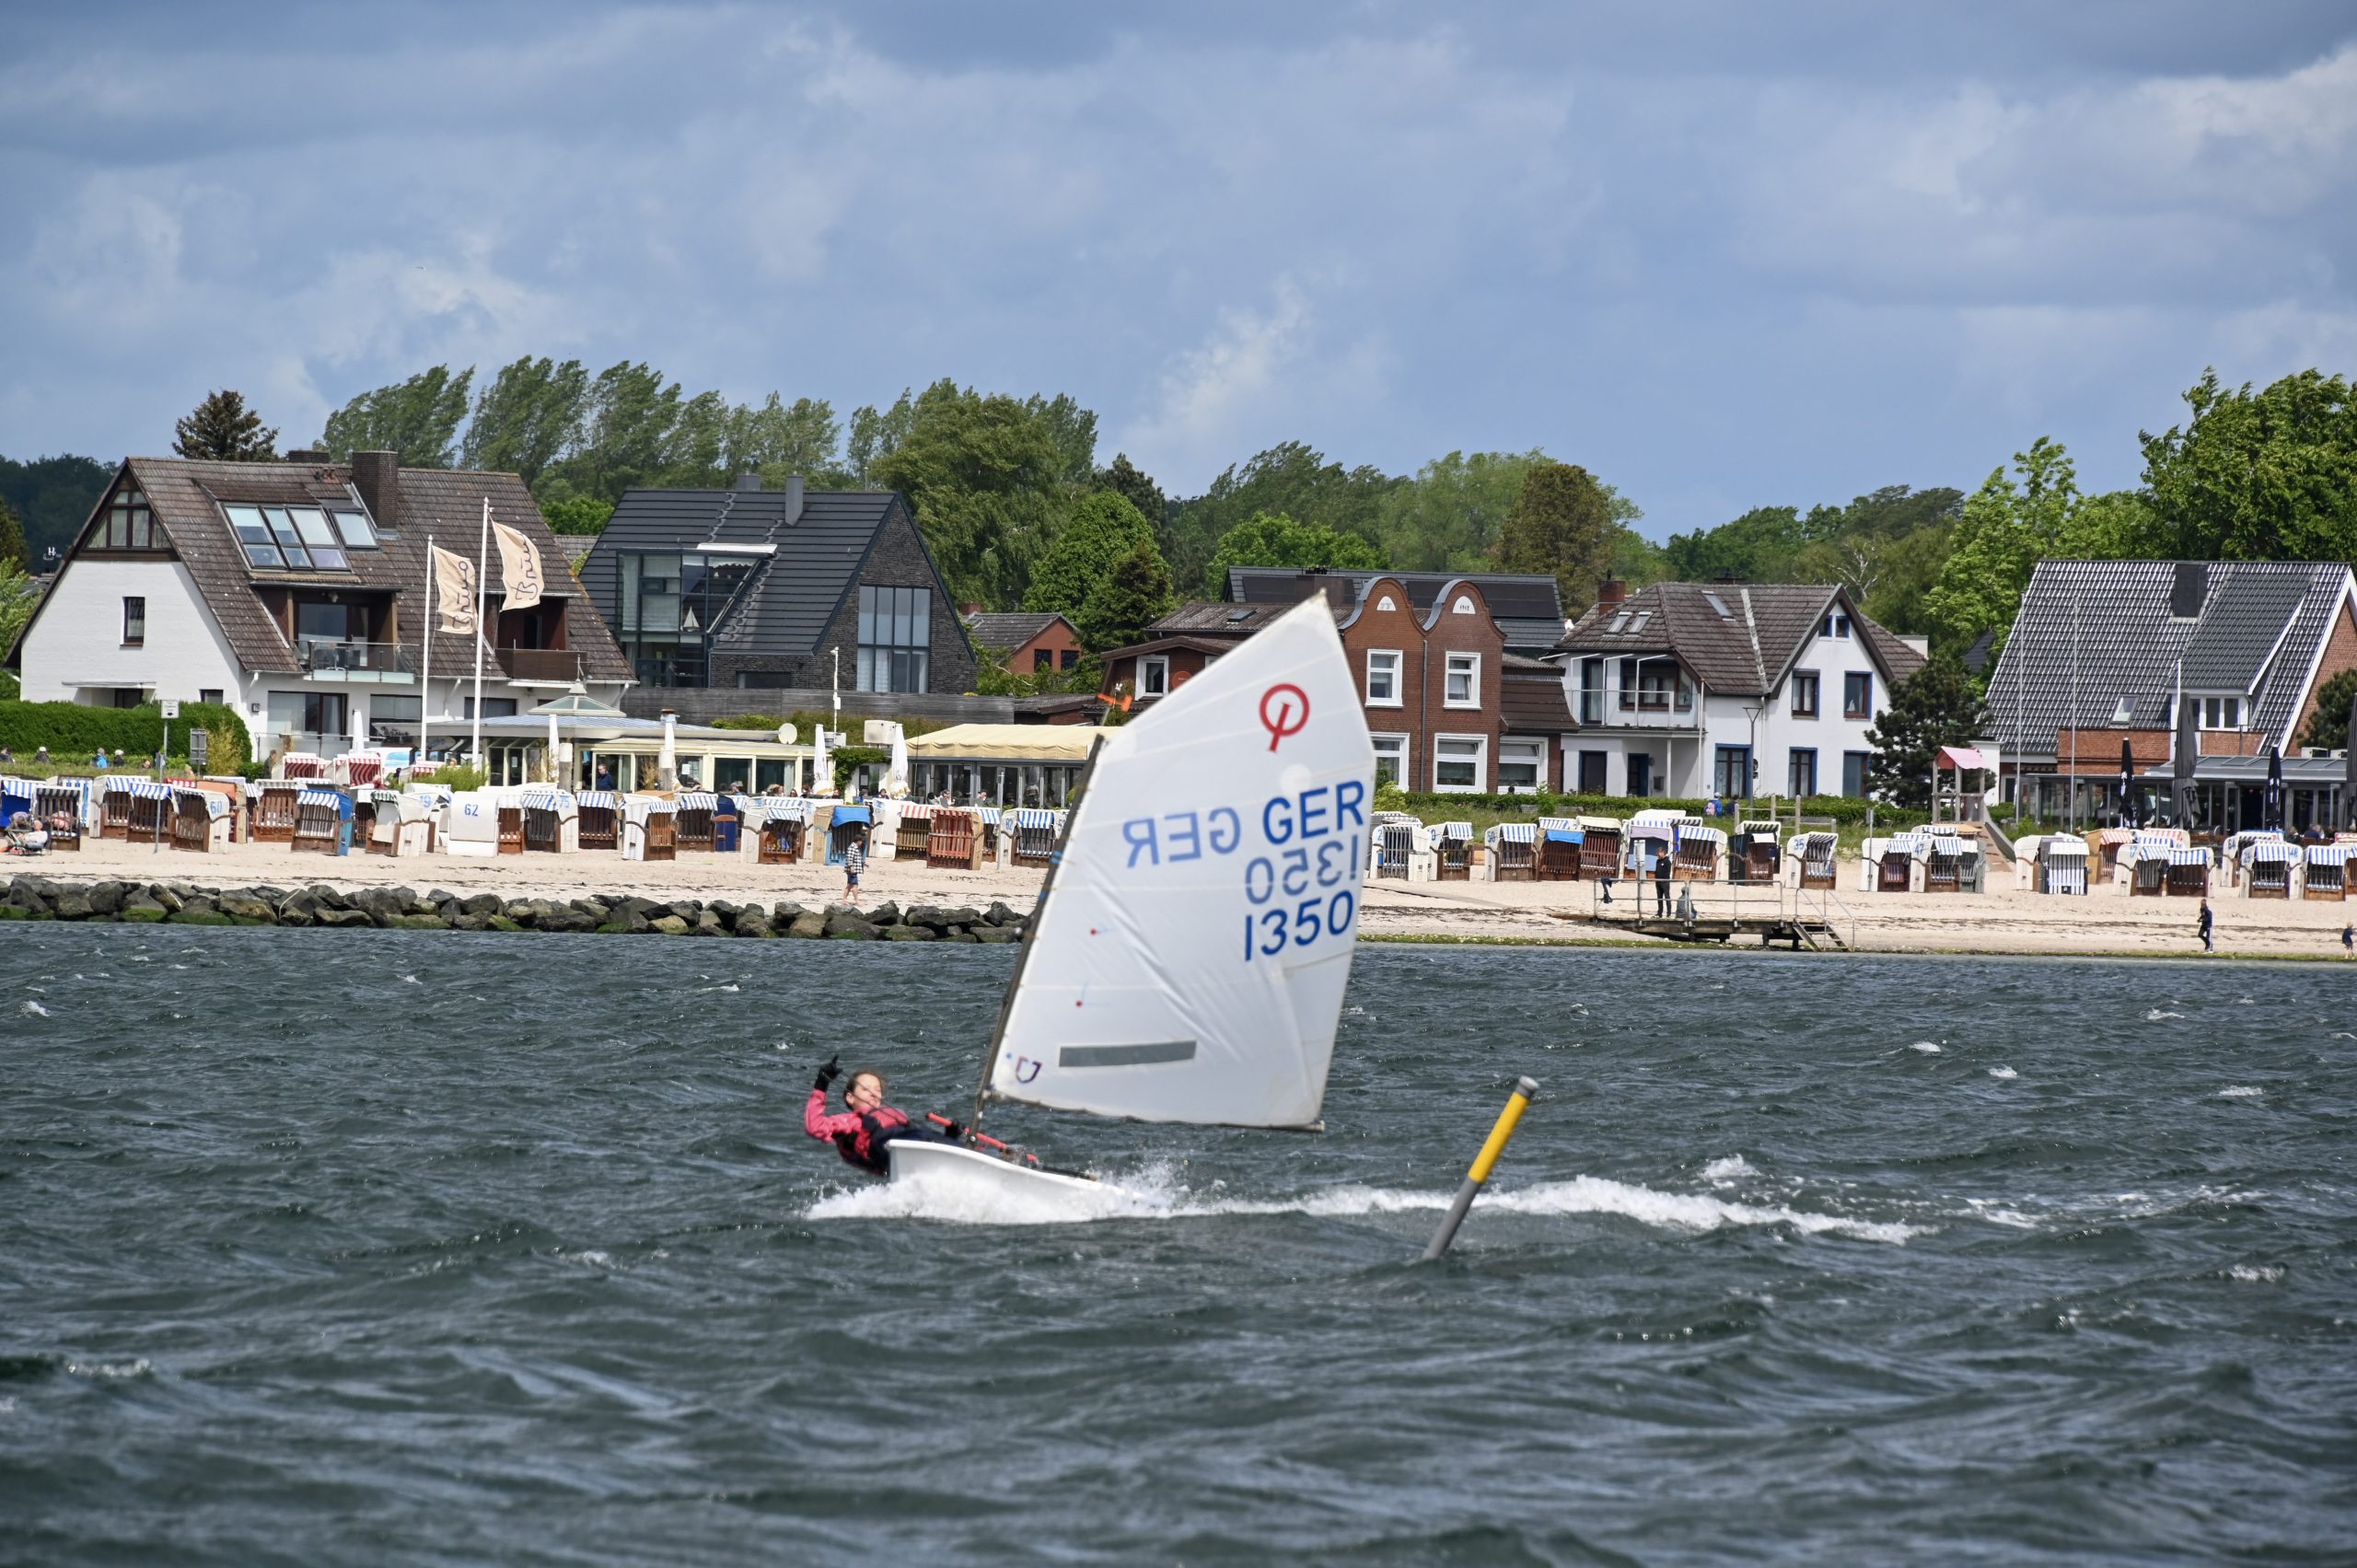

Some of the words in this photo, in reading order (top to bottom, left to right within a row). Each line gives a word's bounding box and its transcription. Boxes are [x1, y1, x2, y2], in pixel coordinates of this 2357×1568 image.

[464, 803, 479, 817] 62
[1262, 780, 1365, 846] GER
[1794, 838, 1805, 850] 35
[1914, 843, 1924, 855] 47
[1244, 889, 1356, 963] 1350
